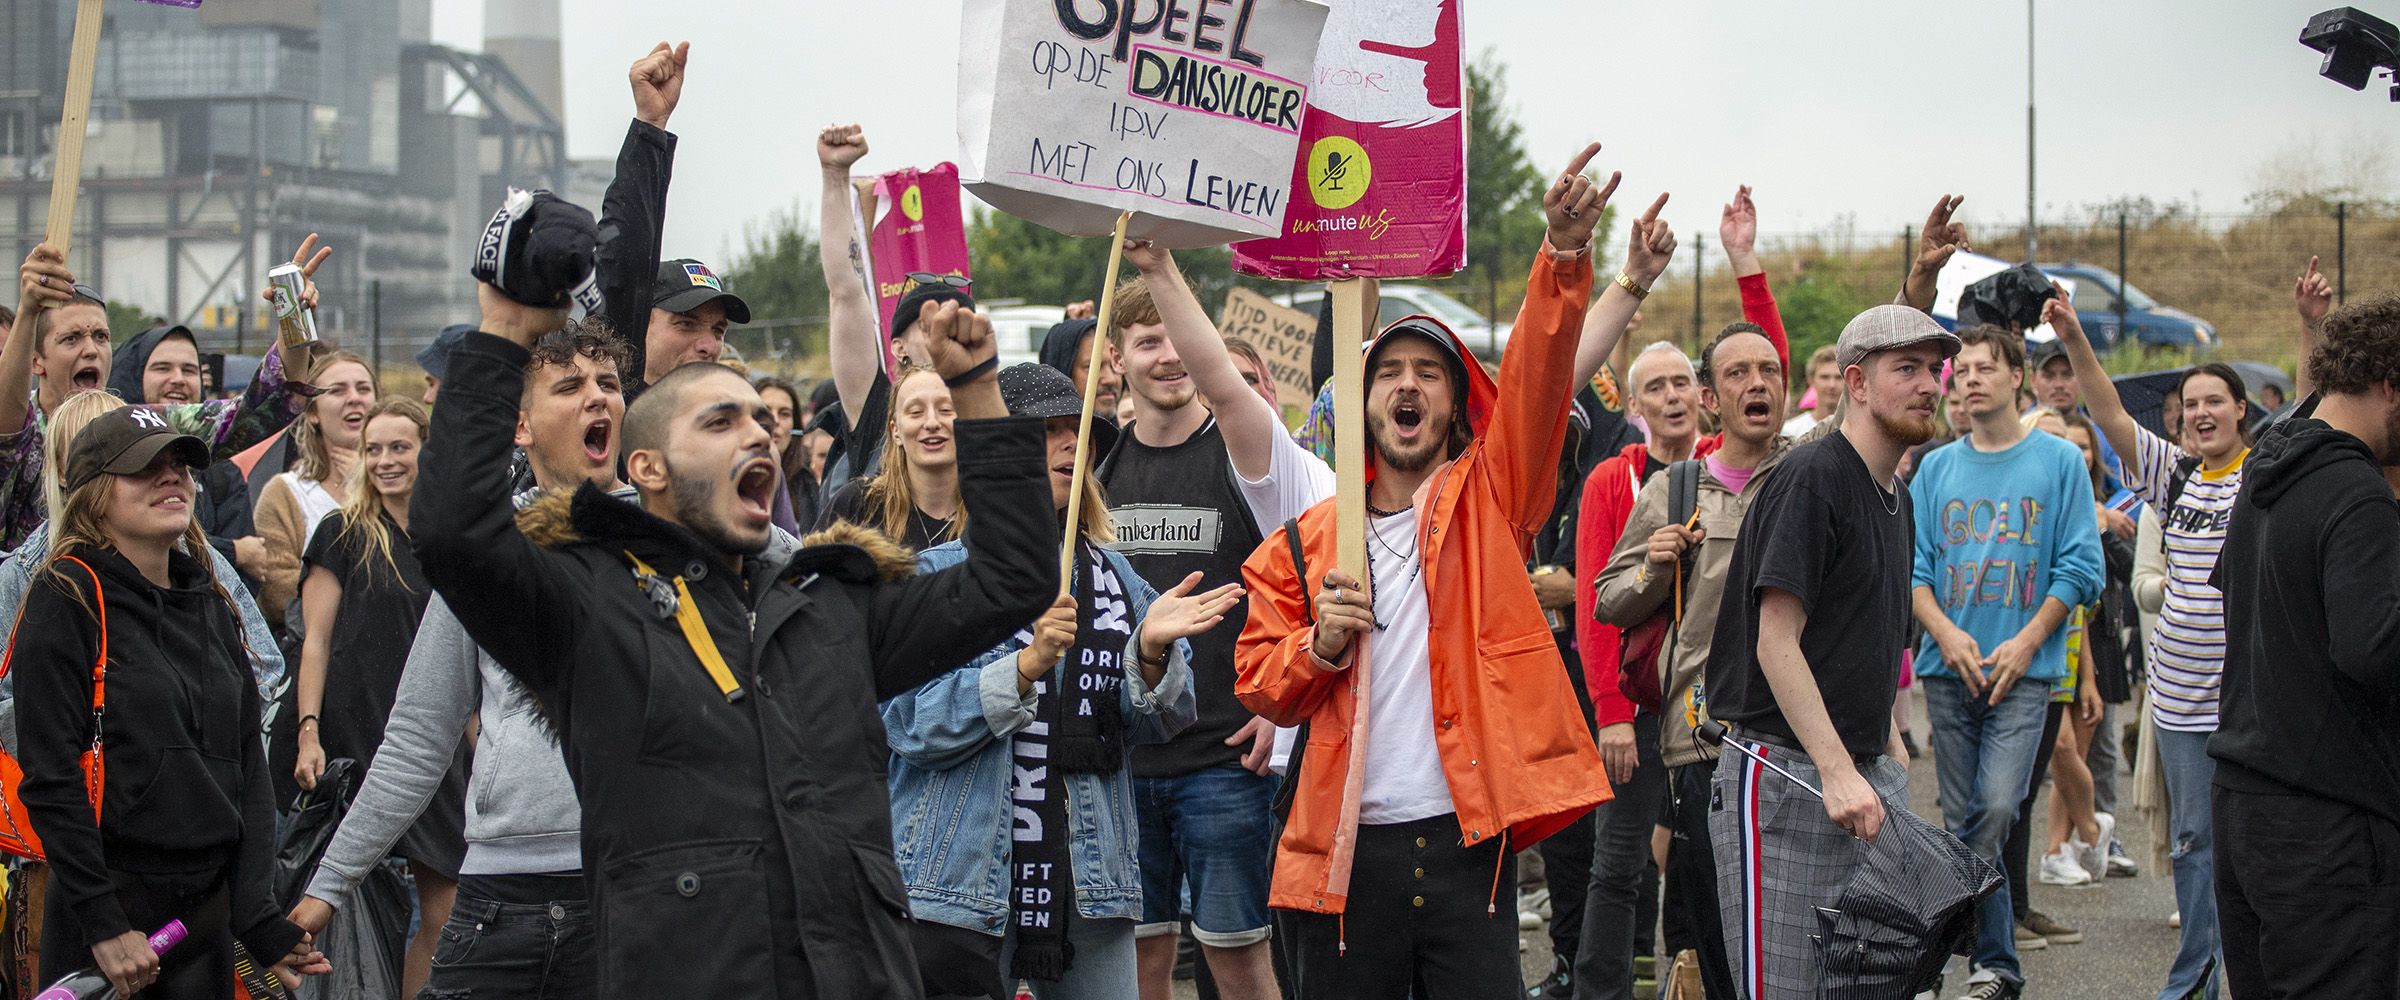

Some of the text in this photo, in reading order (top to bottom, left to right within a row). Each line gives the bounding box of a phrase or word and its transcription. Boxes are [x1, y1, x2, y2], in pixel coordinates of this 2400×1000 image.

[1033, 41, 1112, 89] OP DE
[1320, 66, 1390, 93] VOOR
[1132, 49, 1300, 131] DANSVLOER
[1110, 102, 1169, 141] I.P.V.
[1030, 137, 1281, 217] MET ONS LEVEN
[481, 226, 502, 272] FACE
[581, 283, 601, 307] HE
[1232, 296, 1267, 325] TIJD
[130, 408, 168, 429] NY
[1116, 517, 1202, 542] mberland
[1940, 498, 2045, 546] GOLF
[1942, 558, 2038, 609] OPEN
[1015, 911, 1050, 928] EN
